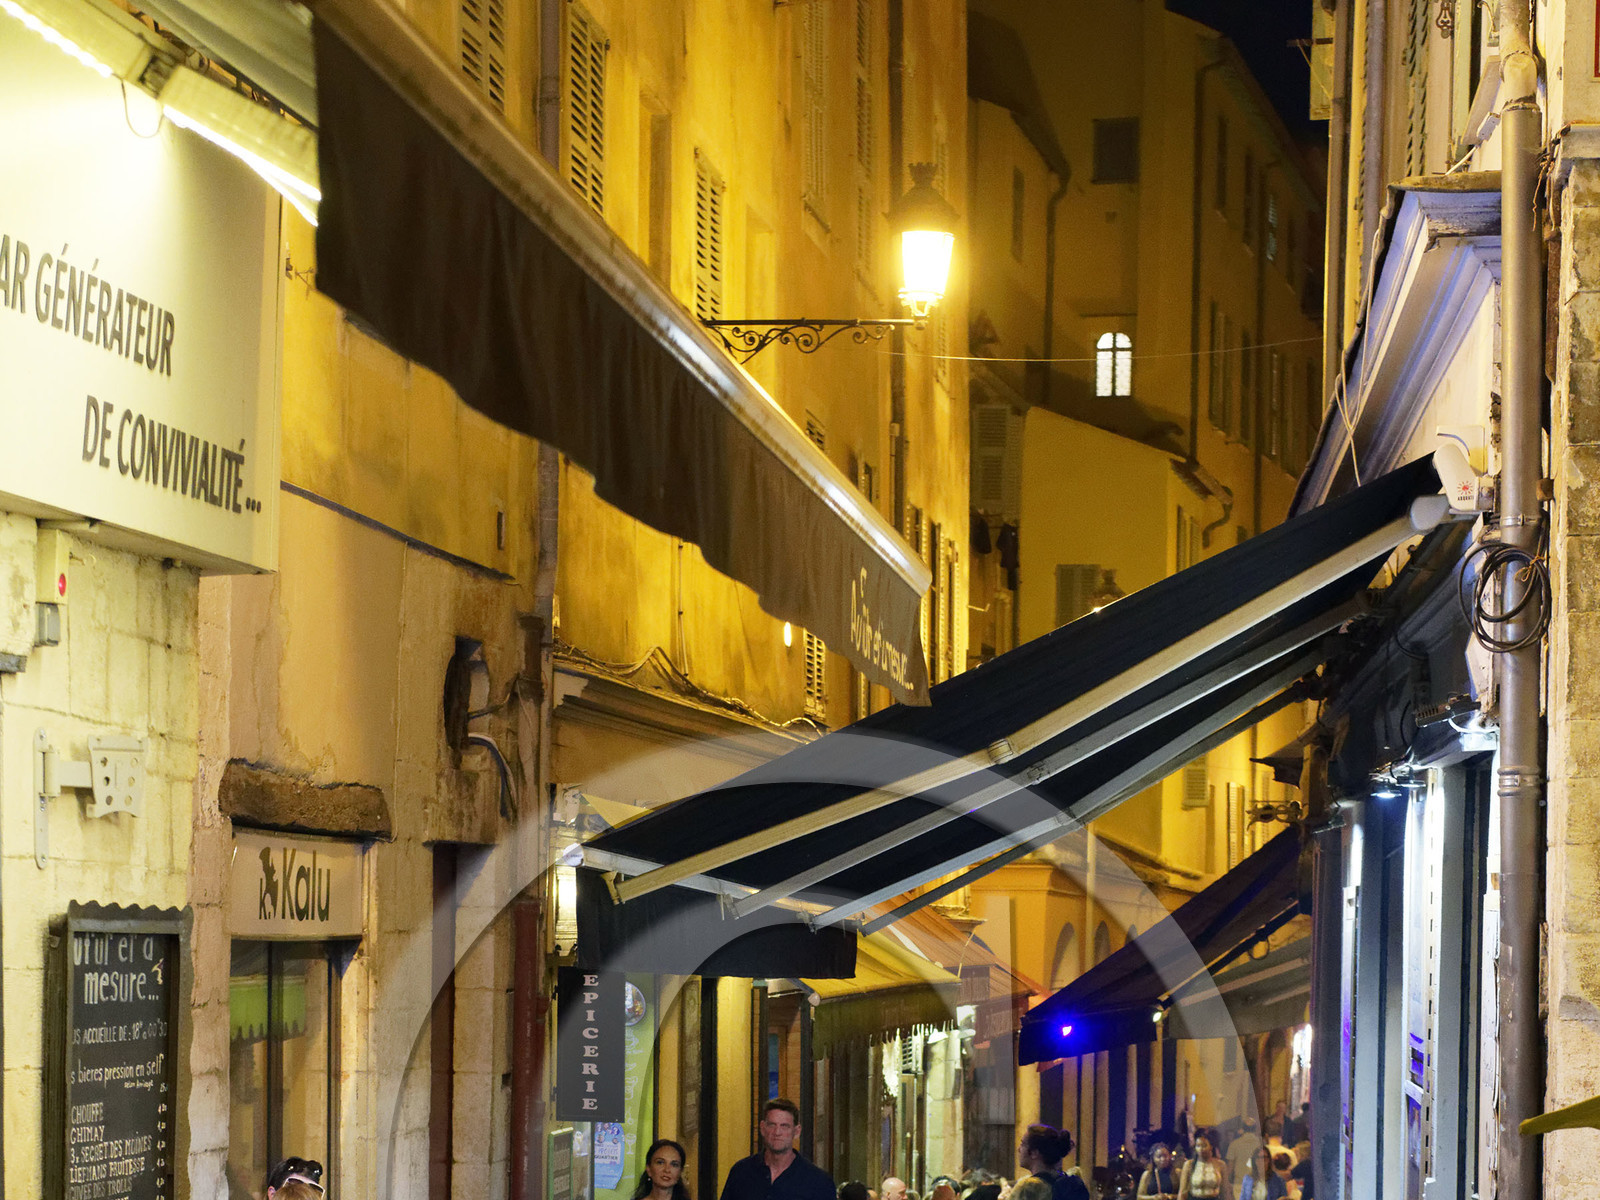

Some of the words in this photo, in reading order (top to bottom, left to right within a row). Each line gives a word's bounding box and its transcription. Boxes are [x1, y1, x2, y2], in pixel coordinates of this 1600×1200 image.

[0, 234, 30, 314] AR
[35, 243, 175, 377] GÉNÉRATEUR
[82, 395, 114, 468] DE
[281, 847, 331, 922] Kalu
[84, 970, 159, 1004] mesure...
[581, 974, 600, 1110] EPICERIE
[104, 1061, 134, 1089] pression
[135, 1064, 145, 1077] en
[146, 1052, 165, 1076] self
[71, 1102, 104, 1125] CHOUFFE
[70, 1125, 105, 1145] CHIMAY
[81, 1141, 109, 1163] SECRET
[107, 1177, 134, 1196] TROLLS
